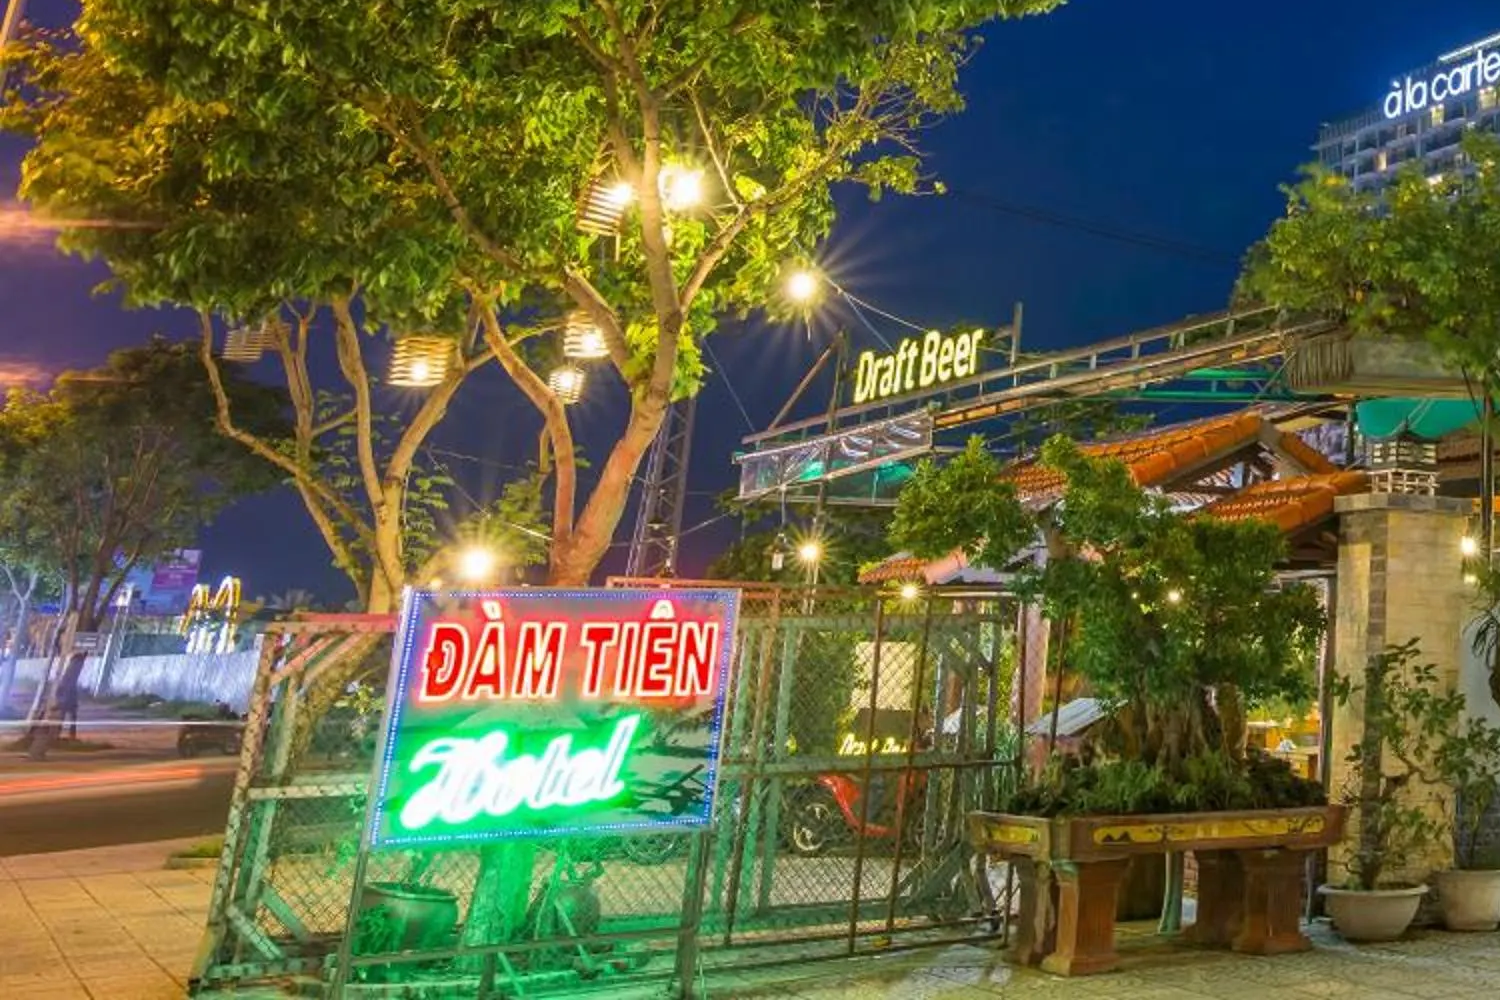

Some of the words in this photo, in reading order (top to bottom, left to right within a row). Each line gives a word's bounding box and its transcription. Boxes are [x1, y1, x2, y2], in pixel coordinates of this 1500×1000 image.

[1384, 80, 1403, 119] à
[1405, 76, 1428, 113] la
[853, 337, 919, 404] Draft
[919, 328, 985, 387] Beer
[420, 600, 568, 700] ĐÀM
[580, 599, 719, 698] TIÊN
[401, 714, 641, 829] Hotel
